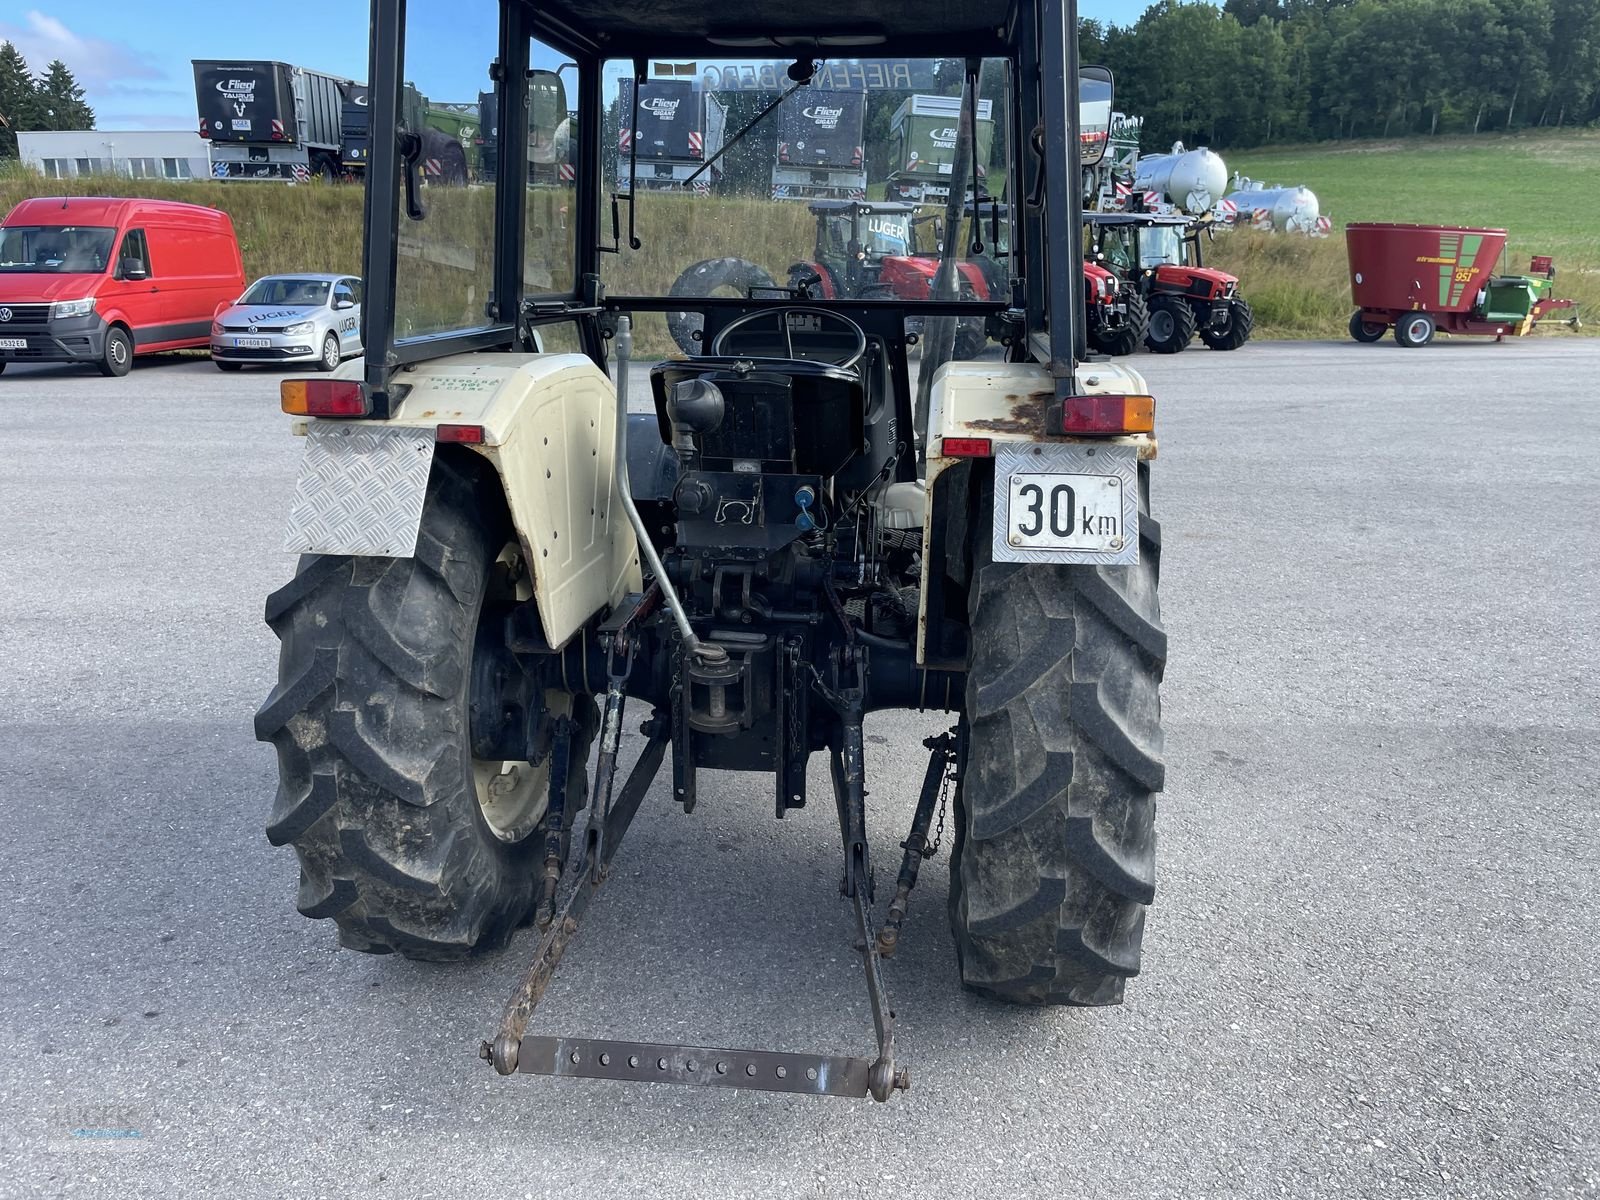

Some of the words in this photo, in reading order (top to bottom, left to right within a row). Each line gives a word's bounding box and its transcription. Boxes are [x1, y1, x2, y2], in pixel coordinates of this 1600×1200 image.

[652, 98, 680, 110] Fliegl
[814, 106, 843, 119] Fliegl
[869, 218, 905, 240] LUGER
[1455, 272, 1472, 282] 951
[247, 310, 299, 324] LUGER
[338, 316, 357, 333] LUGER
[1018, 484, 1076, 538] 30
[1082, 506, 1117, 536] km
